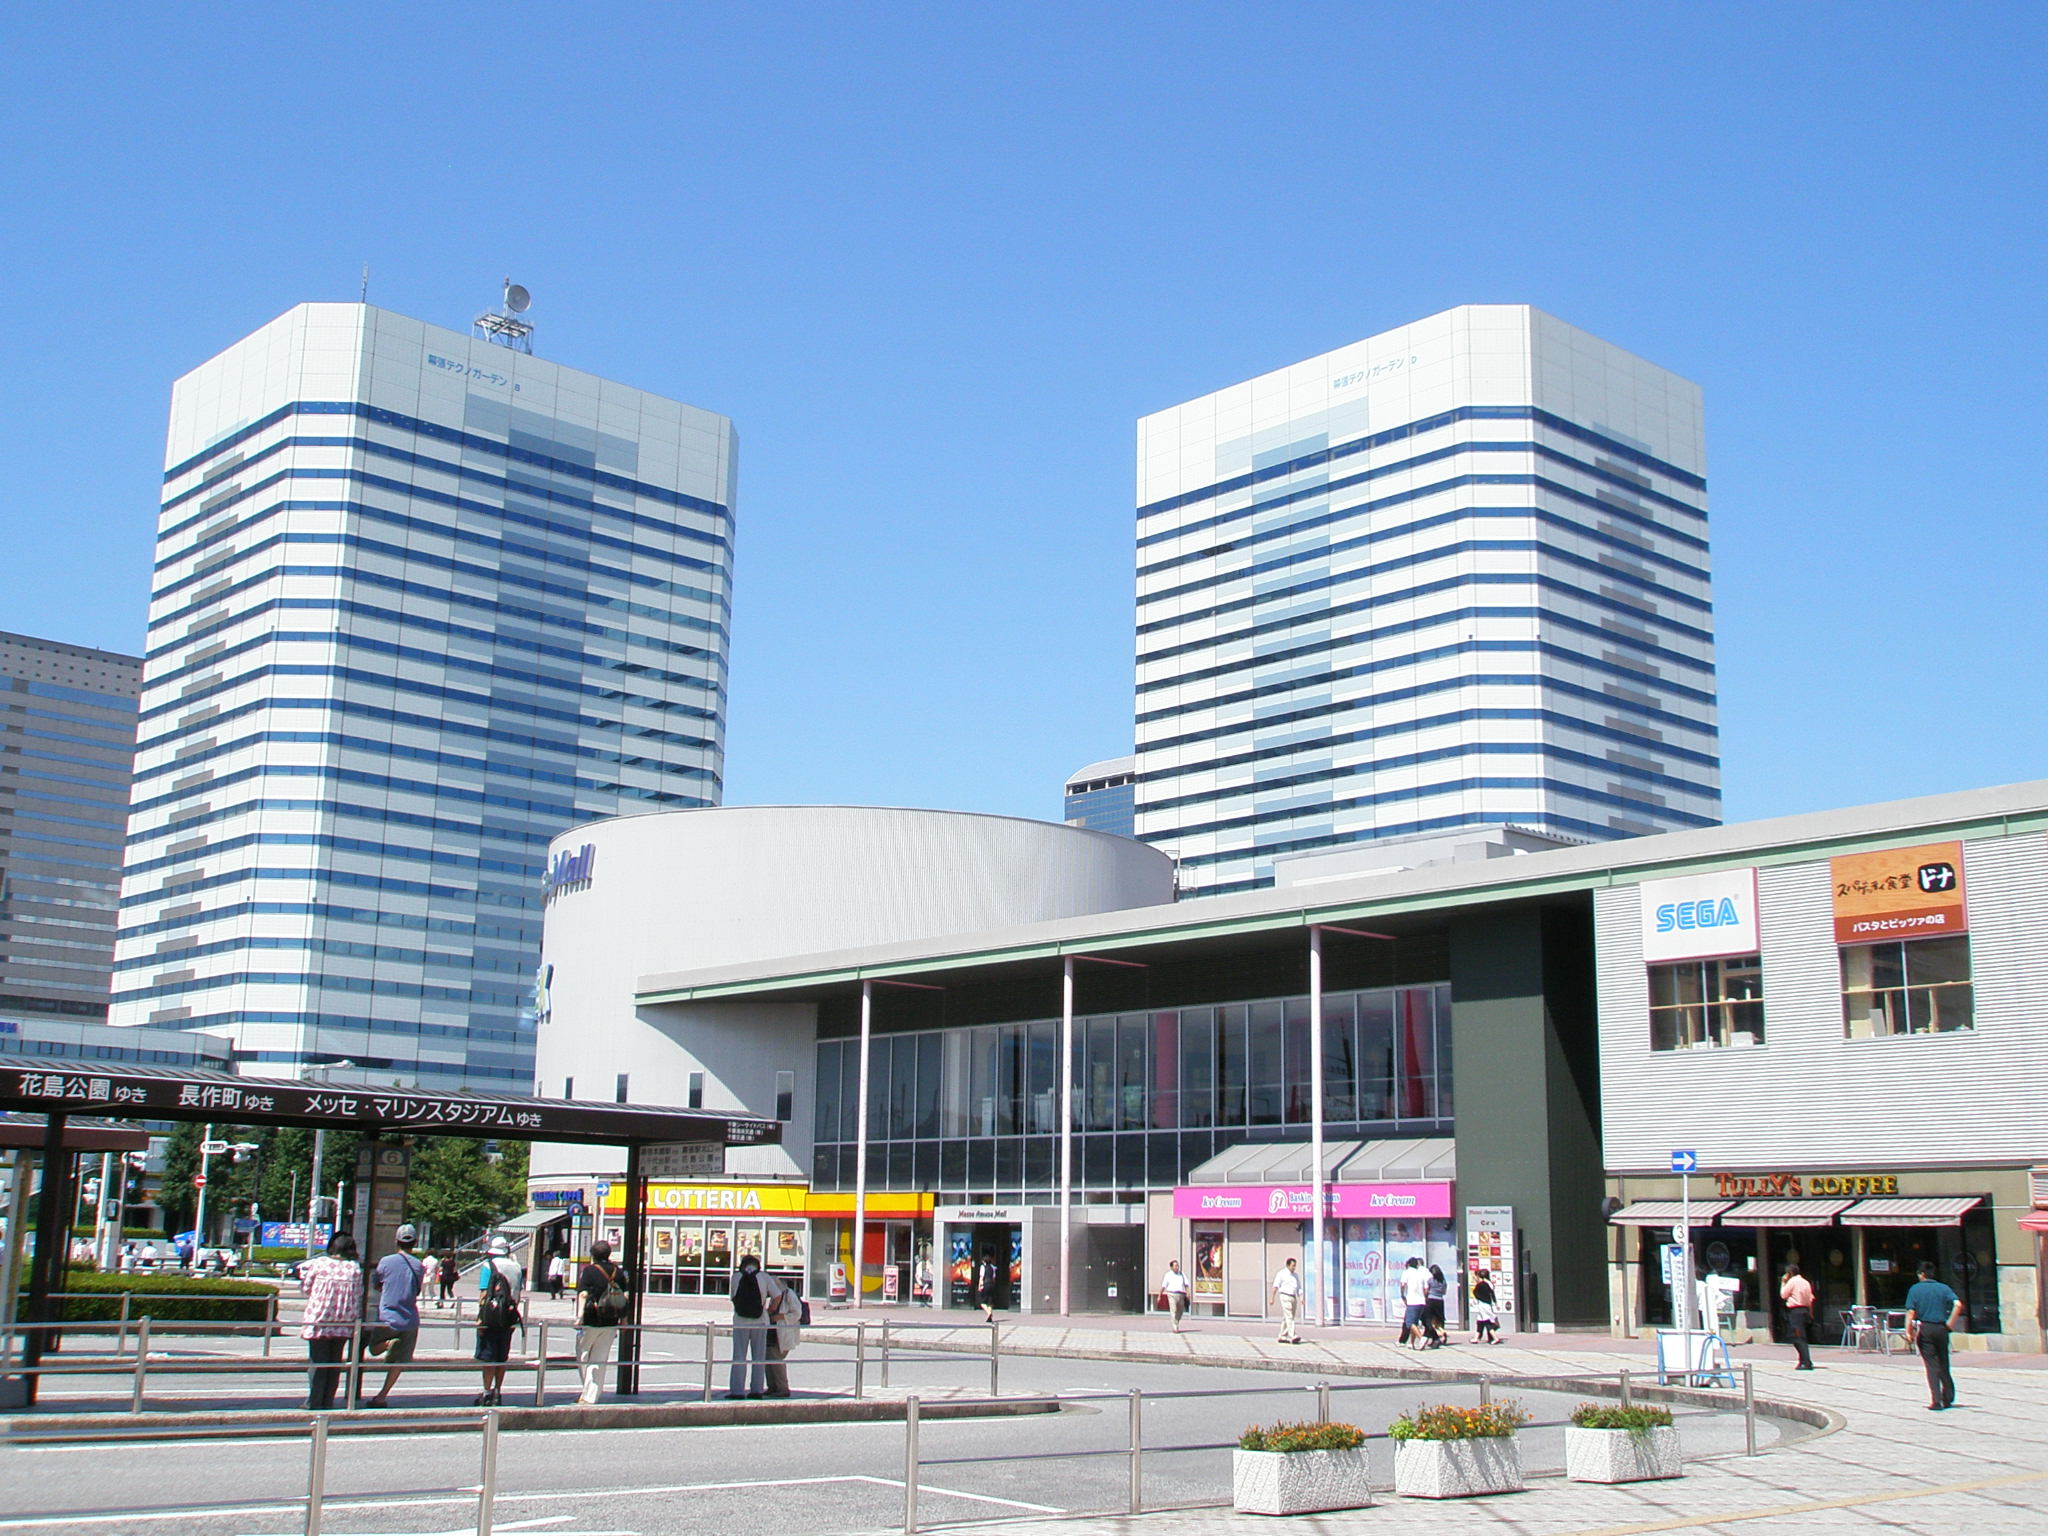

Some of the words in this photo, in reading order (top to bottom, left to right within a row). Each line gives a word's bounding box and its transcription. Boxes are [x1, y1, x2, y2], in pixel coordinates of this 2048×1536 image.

[1920, 867, 1953, 890] ドナ
[1656, 897, 1740, 933] SEGA
[1852, 914, 1945, 933] パスタとピッツァの店
[1808, 1175, 1898, 1196] COFFEE
[653, 1189, 761, 1210] LOTTERIA
[1202, 1195, 1214, 1207] Ice
[1214, 1195, 1241, 1208] Cream
[1370, 1195, 1384, 1207] Ice
[1385, 1194, 1416, 1206] Cream
[1676, 1225, 1685, 1239] 3
